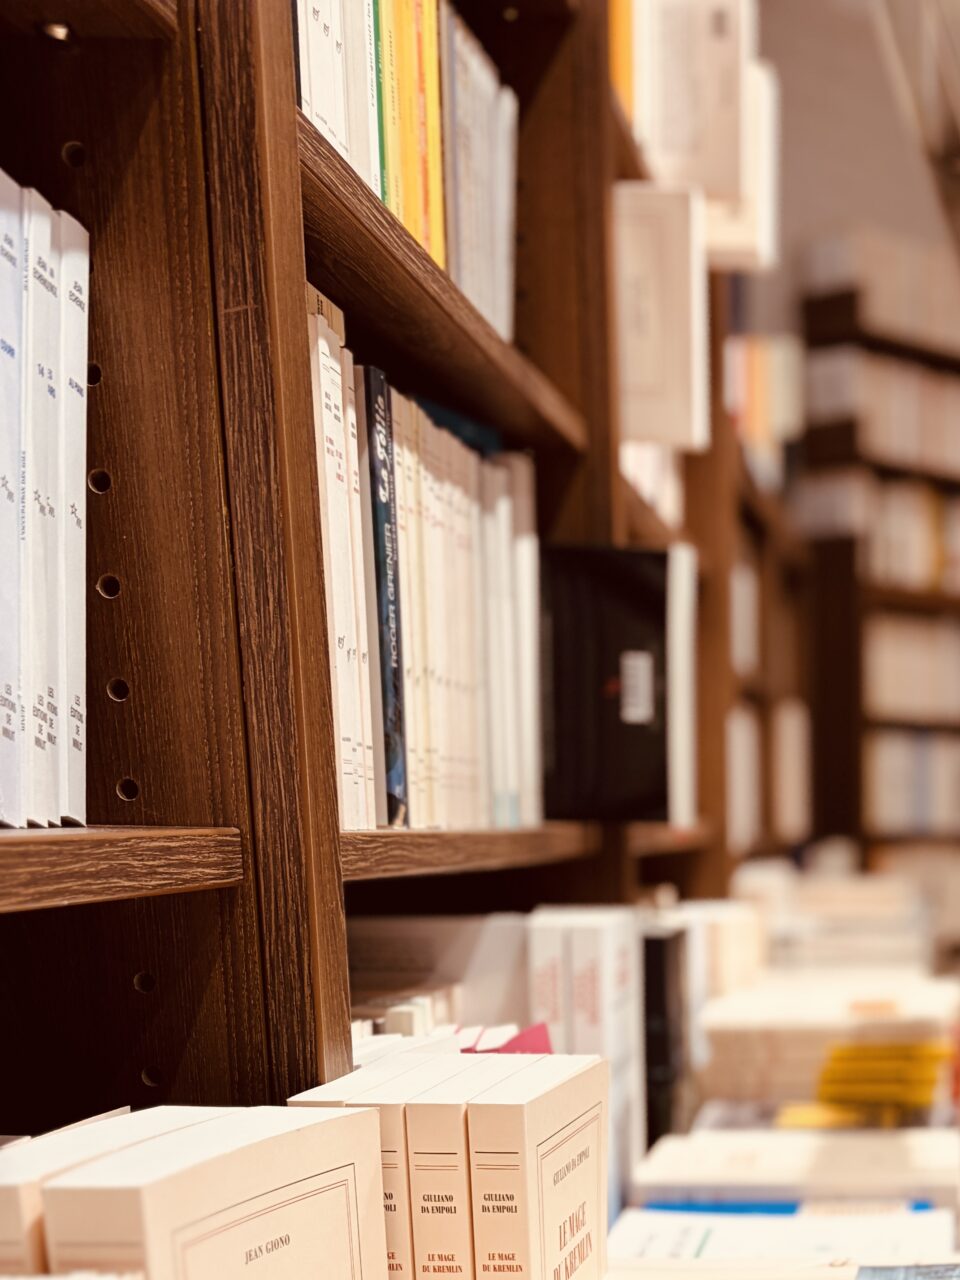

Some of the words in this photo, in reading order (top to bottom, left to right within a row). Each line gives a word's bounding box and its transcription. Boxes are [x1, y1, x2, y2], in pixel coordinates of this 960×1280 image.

[383, 522, 396, 601] GRENIER
[388, 605, 399, 669] ROGER
[422, 1194, 454, 1203] GIULIANO
[483, 1193, 515, 1202] GIULIANO
[421, 1206, 430, 1214] DA
[431, 1206, 457, 1214] EMPOLI
[481, 1205, 490, 1213] DA
[492, 1205, 518, 1214] EMPOLI
[559, 1219, 568, 1252] LE
[569, 1201, 586, 1240] MAGE
[244, 1246, 264, 1265] JEAN
[265, 1233, 291, 1255] GIONO
[428, 1253, 436, 1262] LE
[437, 1253, 455, 1262] MAGE
[488, 1253, 496, 1261] LE
[498, 1253, 516, 1262] MAGE
[422, 1264, 431, 1273] DU
[432, 1265, 463, 1273] KREMLIN
[482, 1264, 491, 1272] DU
[493, 1264, 523, 1273] KREMLIN
